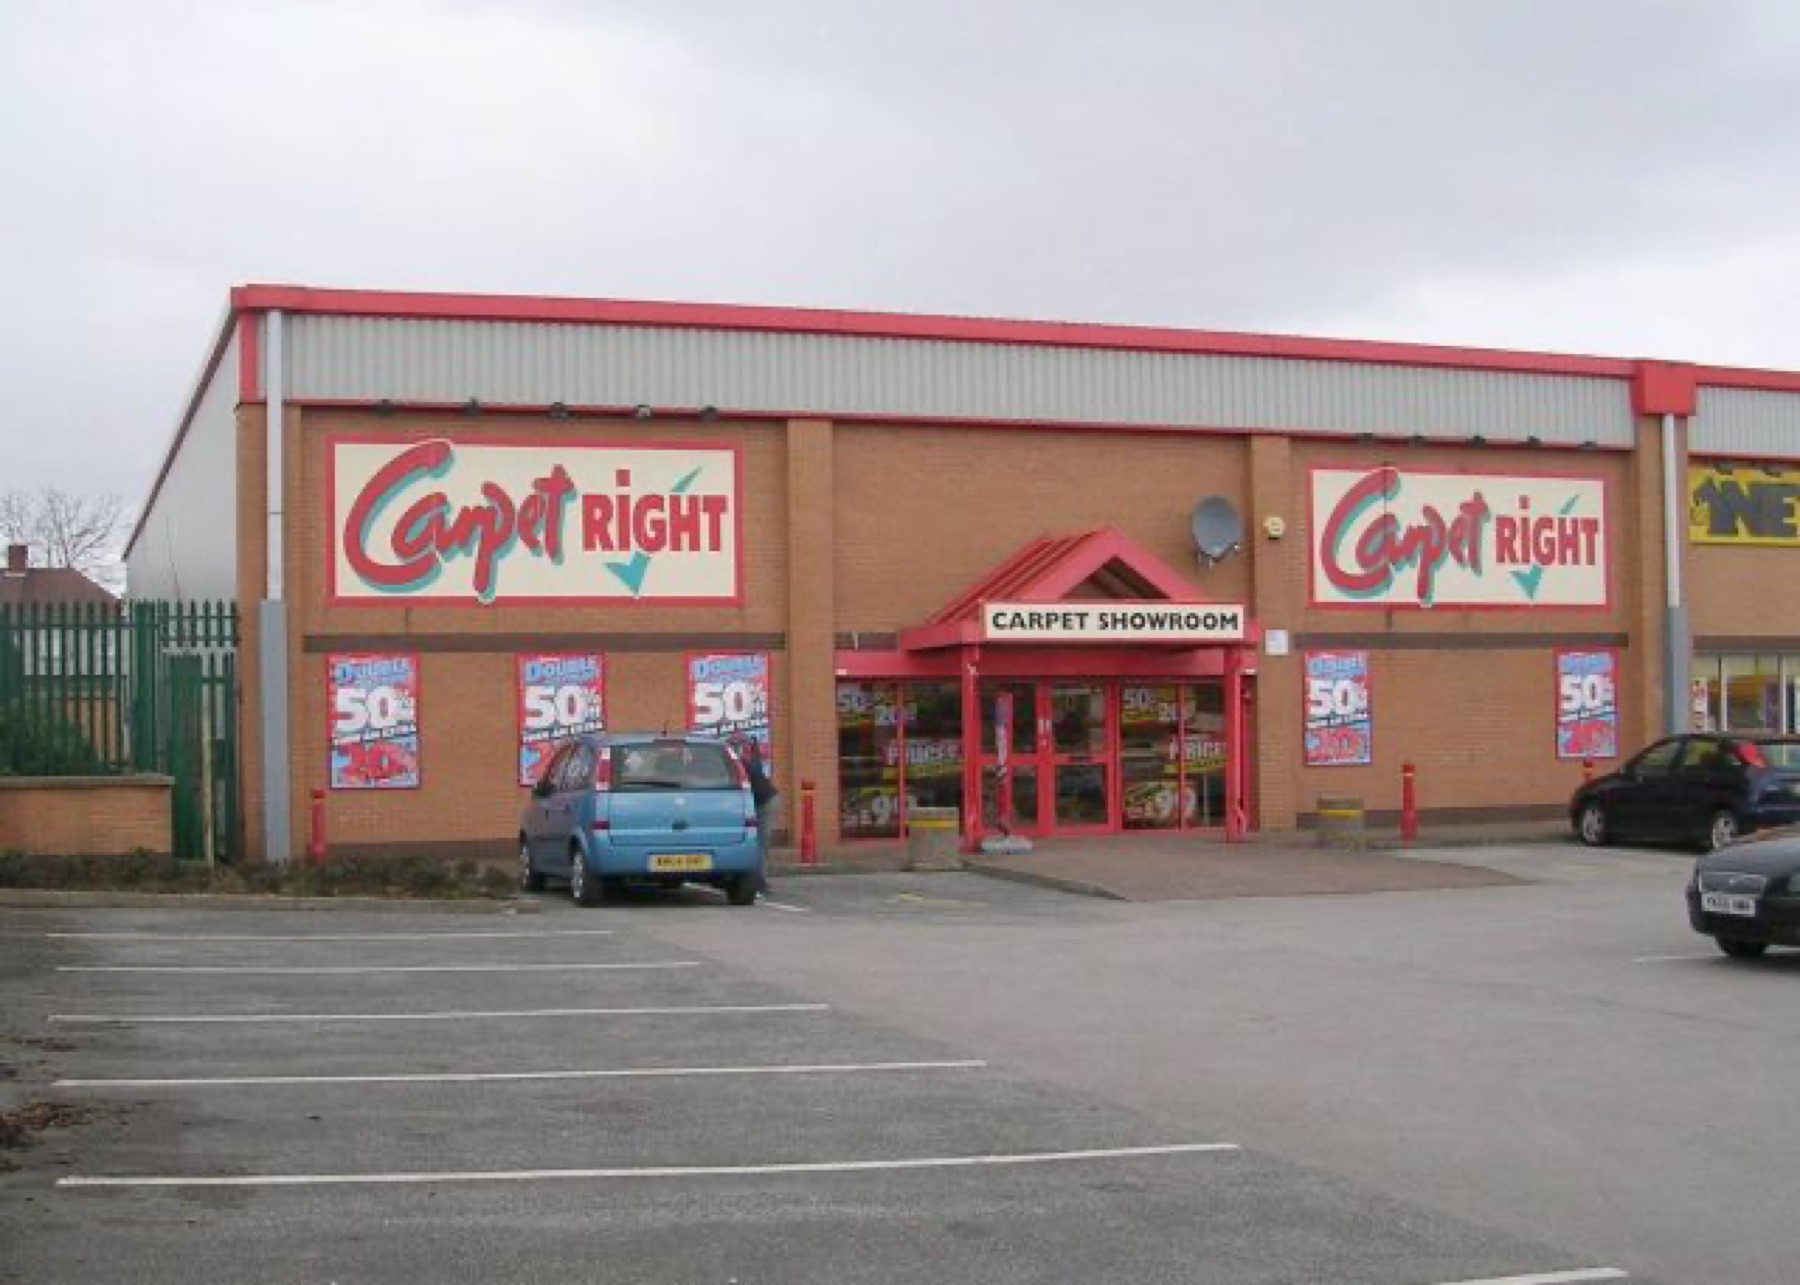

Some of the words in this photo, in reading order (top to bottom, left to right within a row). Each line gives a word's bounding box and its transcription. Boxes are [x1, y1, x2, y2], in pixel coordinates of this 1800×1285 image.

[343, 439, 577, 602] Carpet
[1321, 468, 1491, 607] Carpet
[992, 612, 1089, 630] CARPET
[1099, 612, 1239, 630] SHOWROOM
